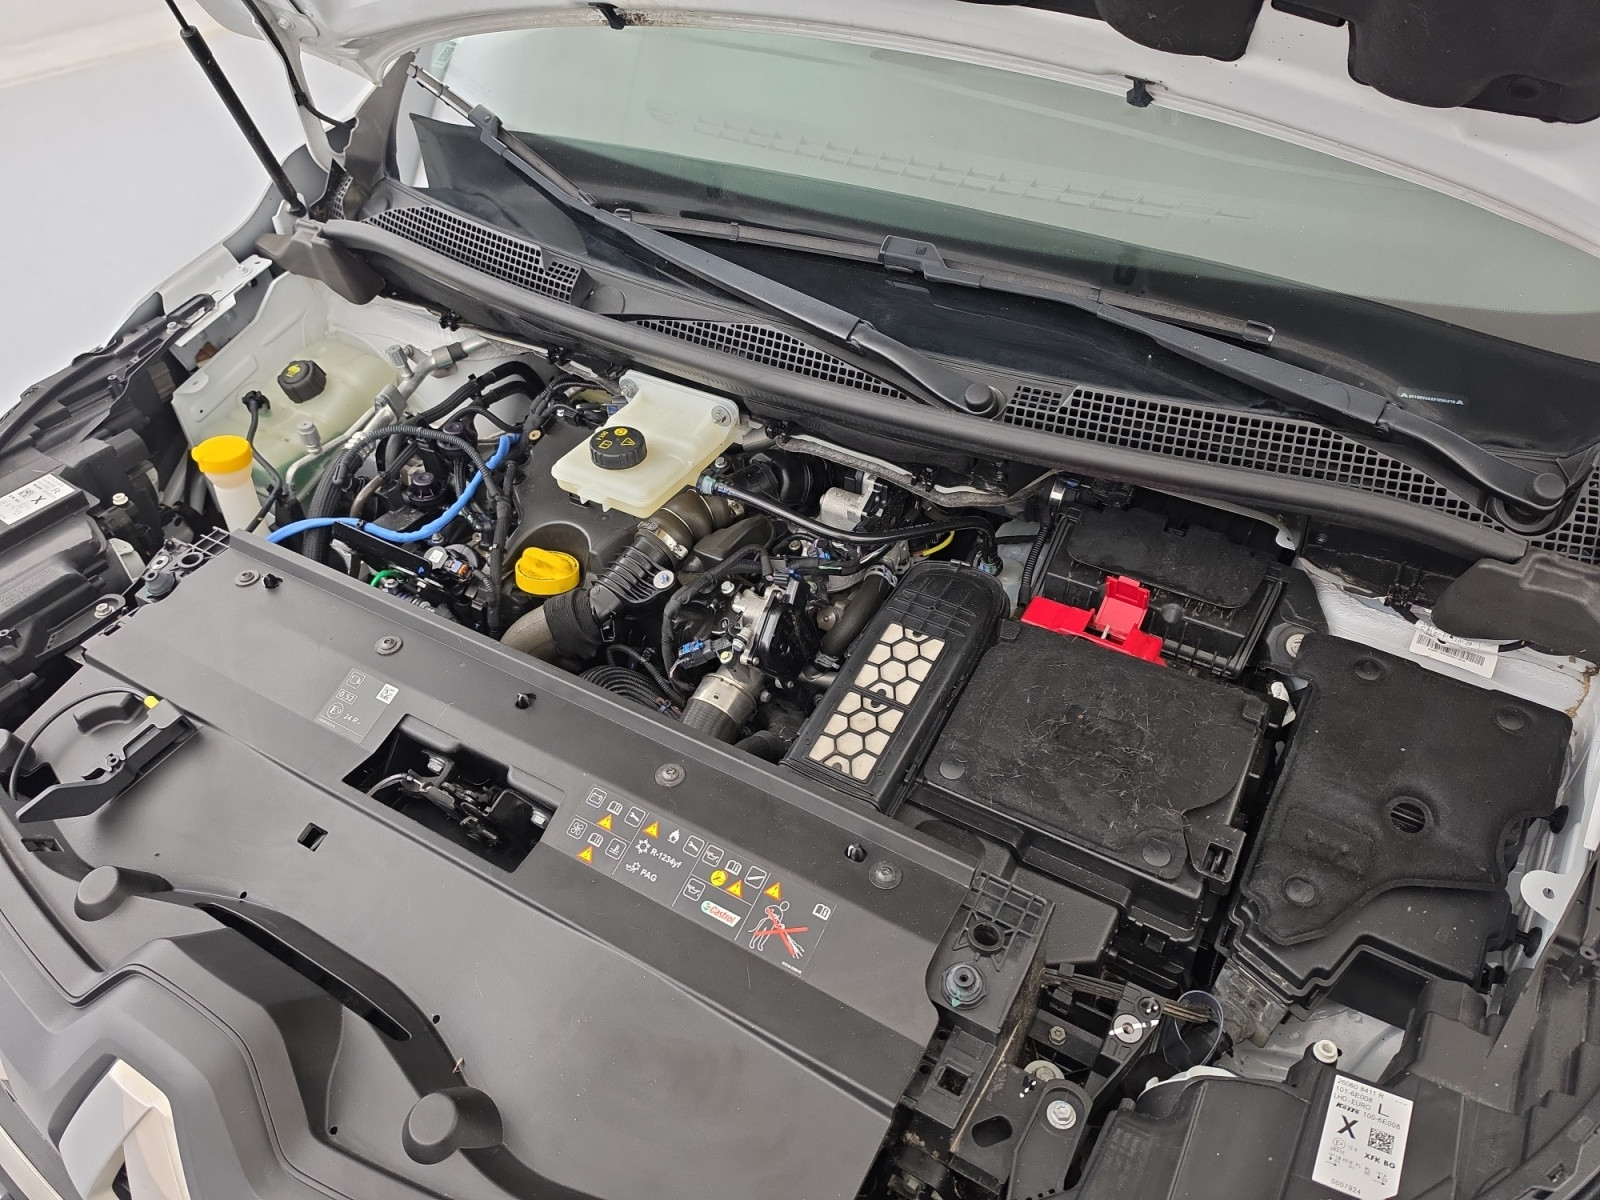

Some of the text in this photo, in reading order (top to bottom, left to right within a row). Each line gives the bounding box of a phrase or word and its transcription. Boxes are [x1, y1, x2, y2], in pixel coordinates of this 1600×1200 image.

[30, 495, 47, 505] X
[338, 691, 354, 702] 0.52
[343, 713, 352, 721] 24
[649, 847, 683, 869] R-1234yf
[639, 868, 658, 883] PAG
[709, 904, 737, 925] Castrol
[1337, 1077, 1359, 1091] 26060
[1360, 1086, 1376, 1097] 8411
[1377, 1102, 1390, 1118] L
[1336, 1114, 1359, 1140] X
[1363, 1111, 1401, 1130] 100-6E008
[1363, 1152, 1396, 1169] XFK BG
[1330, 1178, 1361, 1195] 0007924
